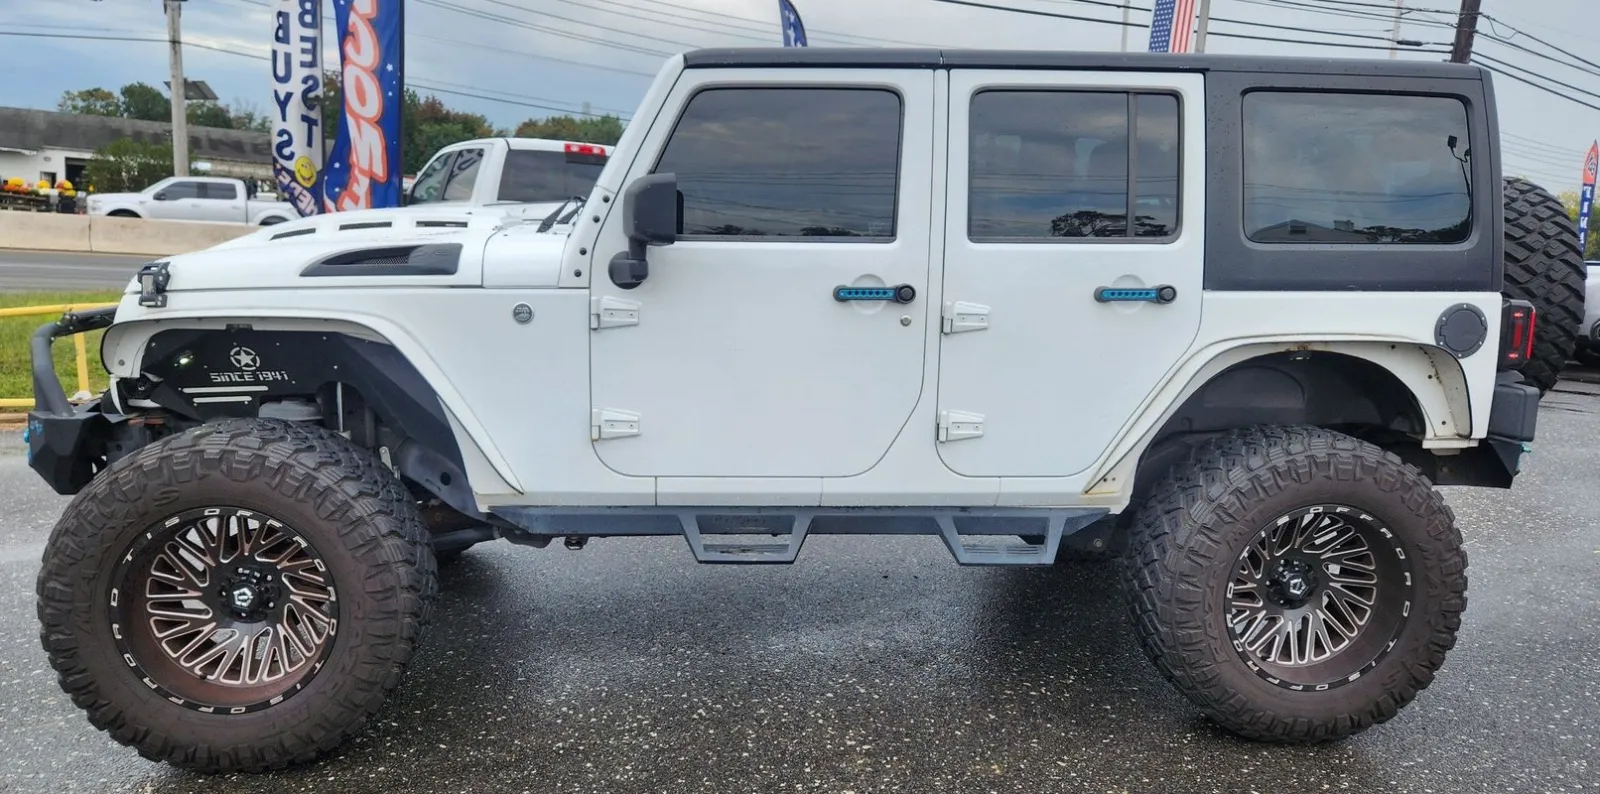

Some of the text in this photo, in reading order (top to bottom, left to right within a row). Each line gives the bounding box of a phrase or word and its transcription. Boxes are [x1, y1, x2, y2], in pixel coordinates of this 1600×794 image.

[209, 370, 289, 382] SINCE 1941
[122, 516, 180, 565] TIS
[1240, 514, 1290, 560] TIS
[269, 659, 326, 706] TIS
[1348, 638, 1398, 683] TIS
